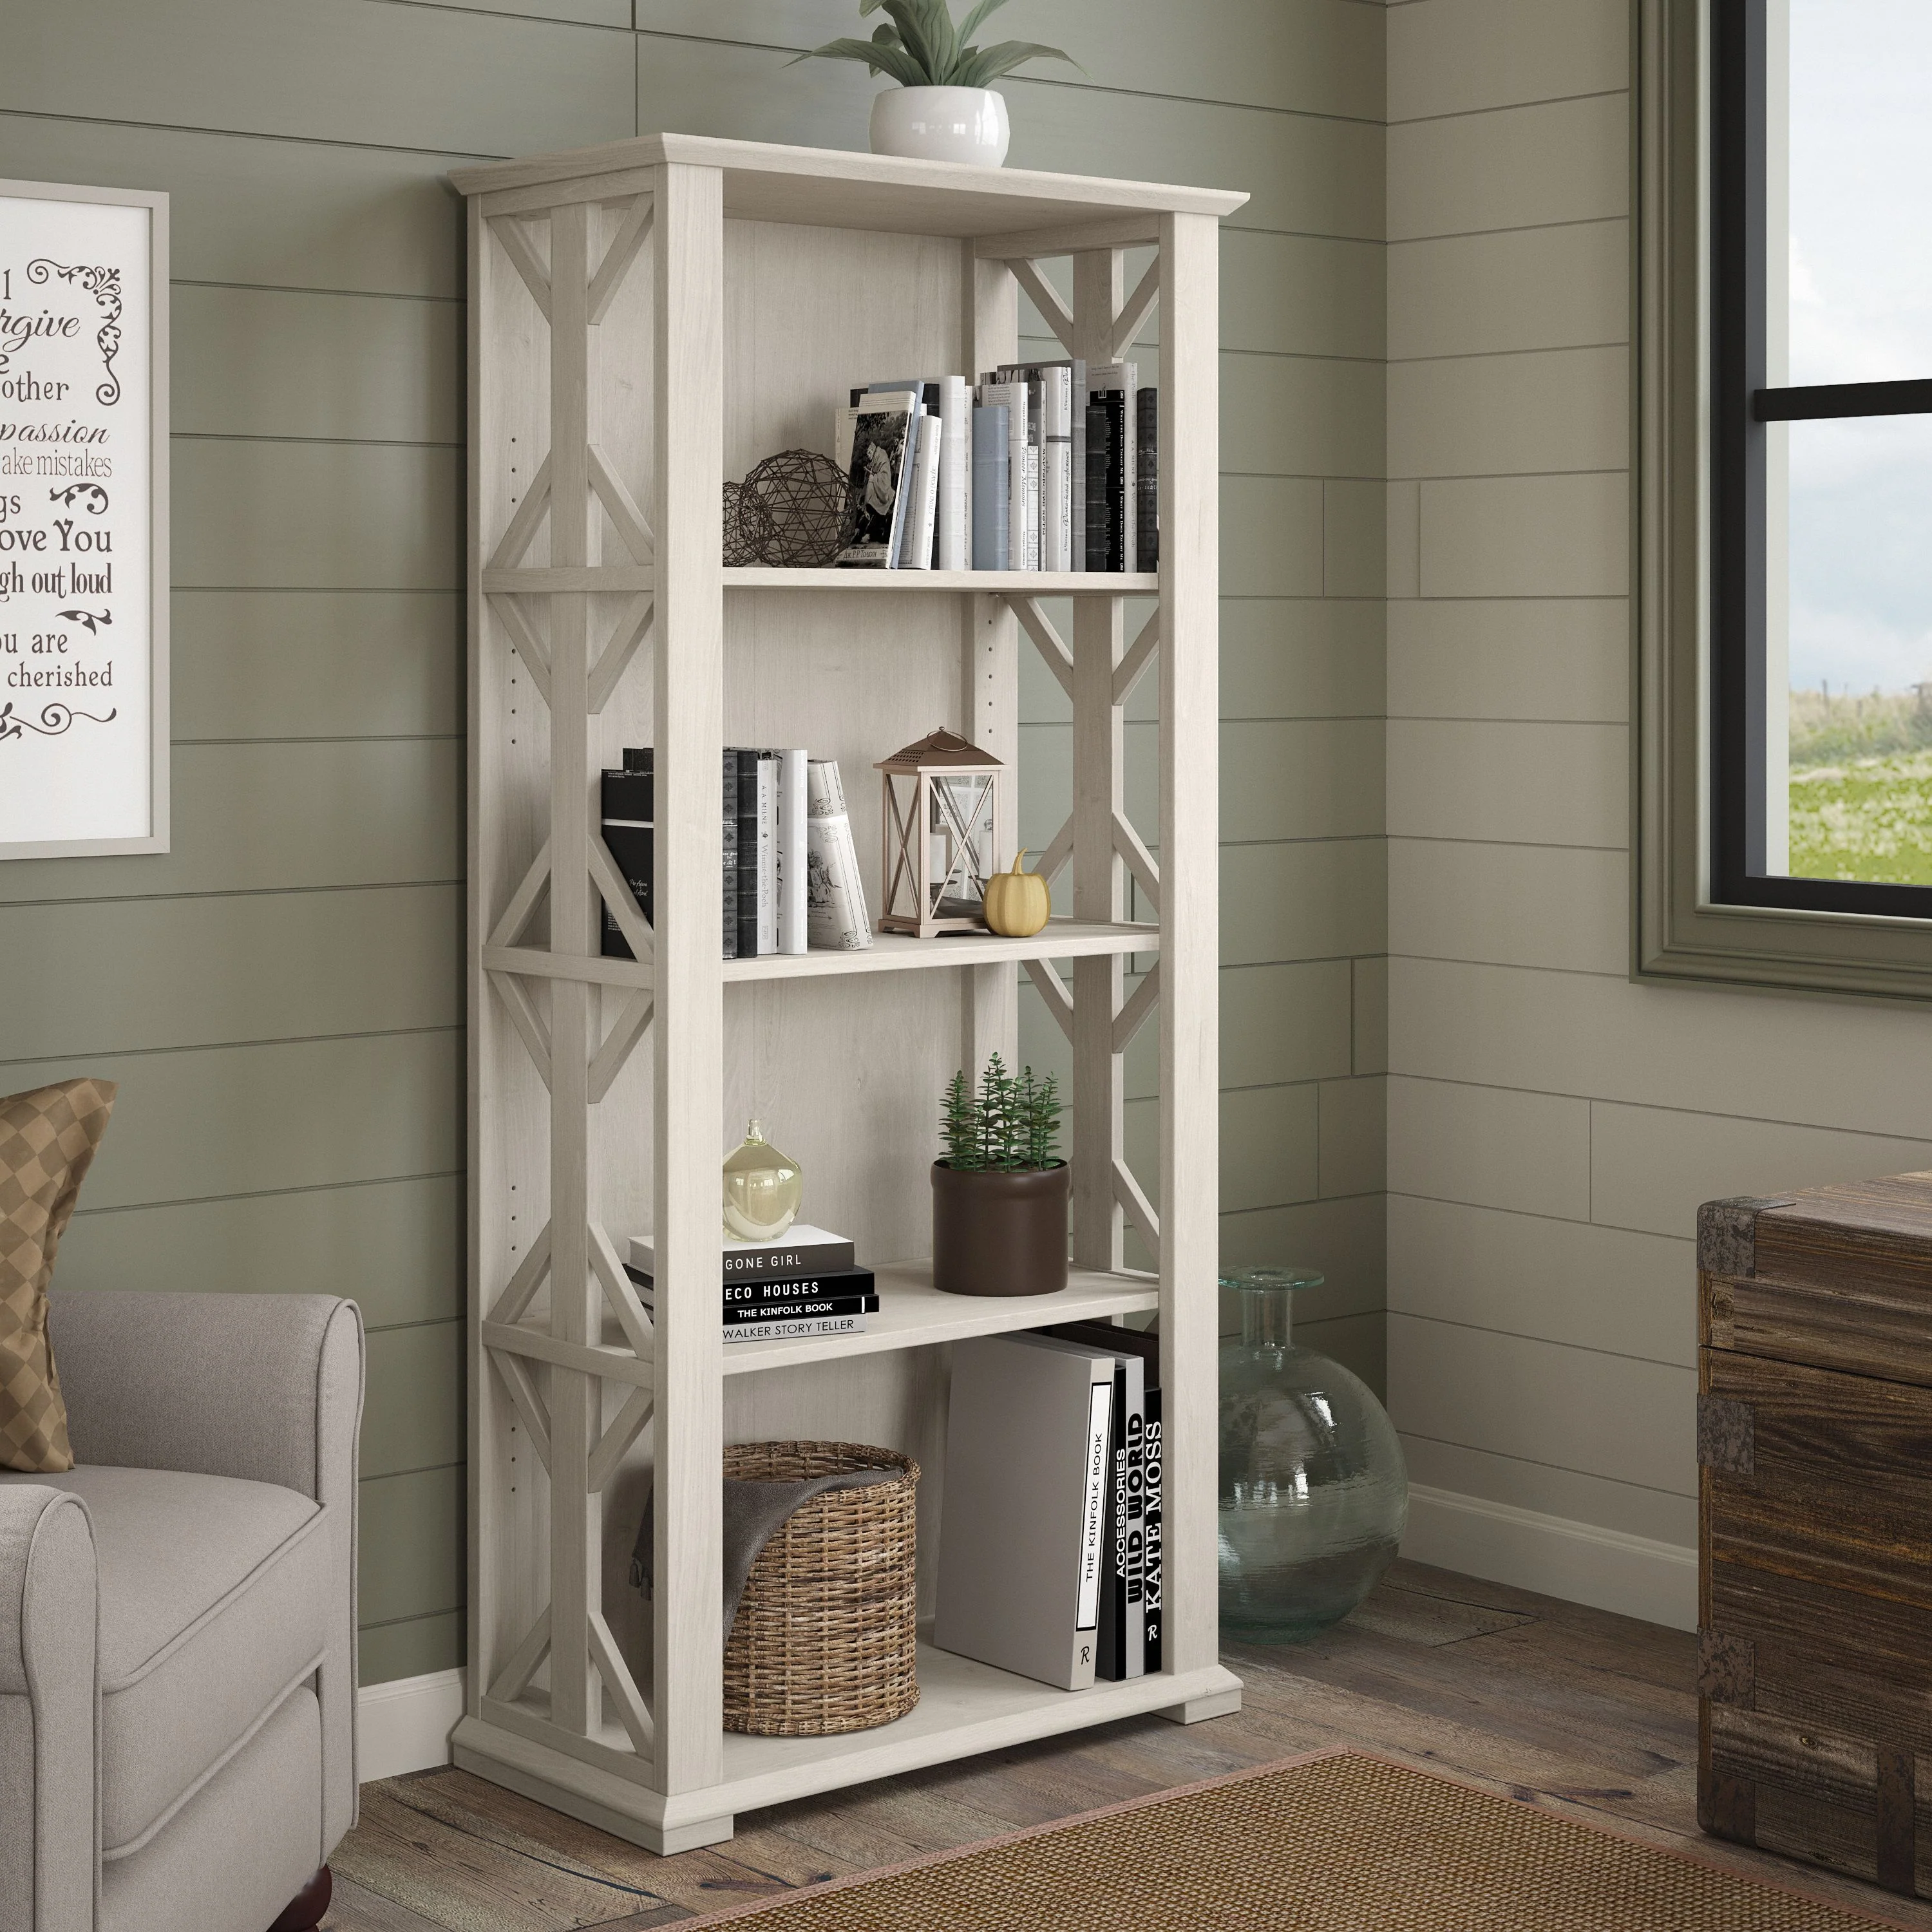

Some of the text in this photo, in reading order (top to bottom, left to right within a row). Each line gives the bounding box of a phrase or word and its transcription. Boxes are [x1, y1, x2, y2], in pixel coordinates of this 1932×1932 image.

[2, 371, 69, 402] other
[37, 448, 112, 477] mistakes
[53, 518, 112, 553] You
[32, 565, 66, 598] out
[70, 562, 112, 594] loud
[32, 634, 68, 654] are
[8, 661, 113, 687] cherished
[725, 1255, 801, 1270] GONE GIRL
[725, 1282, 819, 1300] ECO HOUSES
[737, 1303, 833, 1318] THE KINFOLK BOOK
[723, 1320, 854, 1339] WALKER STORY TELLER
[1086, 1433, 1103, 1582] THE KINFOLK BOOK
[1116, 1448, 1126, 1578] ACCESSORIES
[1128, 1413, 1143, 1604] WILD WORLD
[1145, 1421, 1162, 1613] KATE MOSS
